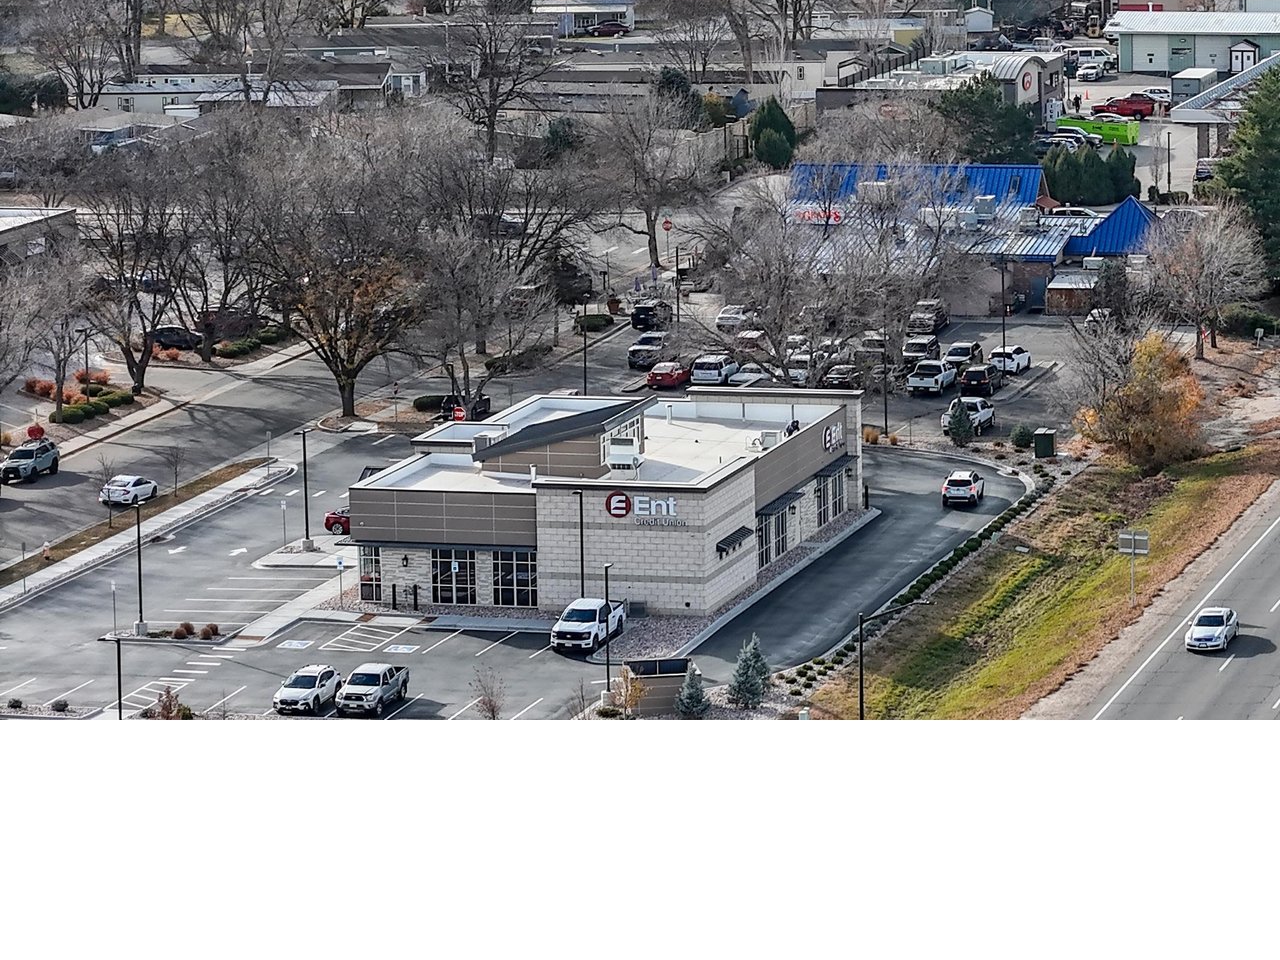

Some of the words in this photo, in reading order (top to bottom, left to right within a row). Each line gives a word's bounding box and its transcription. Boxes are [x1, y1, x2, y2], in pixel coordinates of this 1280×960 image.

[633, 496, 677, 516] Ent
[634, 517, 660, 526] Credit
[662, 518, 688, 527] Union
